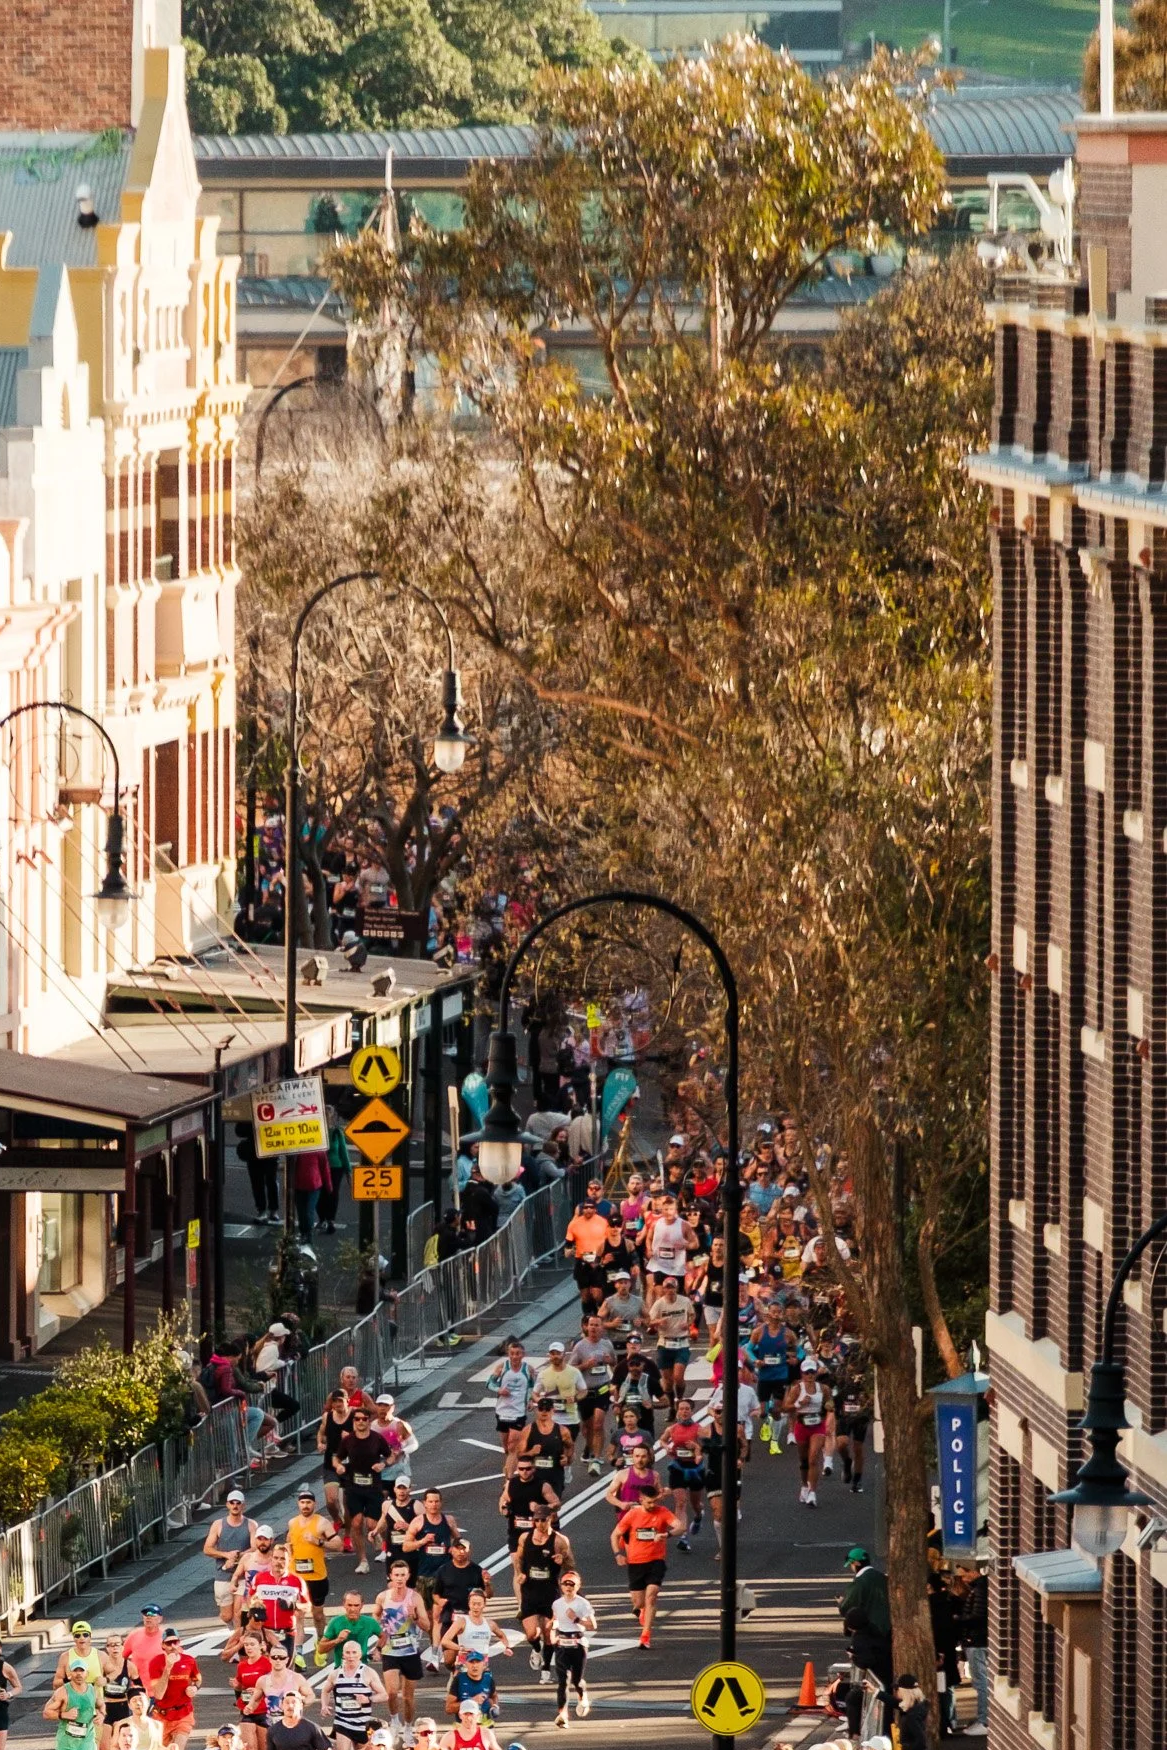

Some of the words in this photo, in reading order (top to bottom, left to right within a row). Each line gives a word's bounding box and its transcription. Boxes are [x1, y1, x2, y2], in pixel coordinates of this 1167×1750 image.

[261, 1105, 272, 1120] C
[284, 1126, 295, 1136] TO
[265, 1140, 285, 1148] SUN
[362, 1170, 393, 1187] 25
[951, 1417, 965, 1535] POLICE
